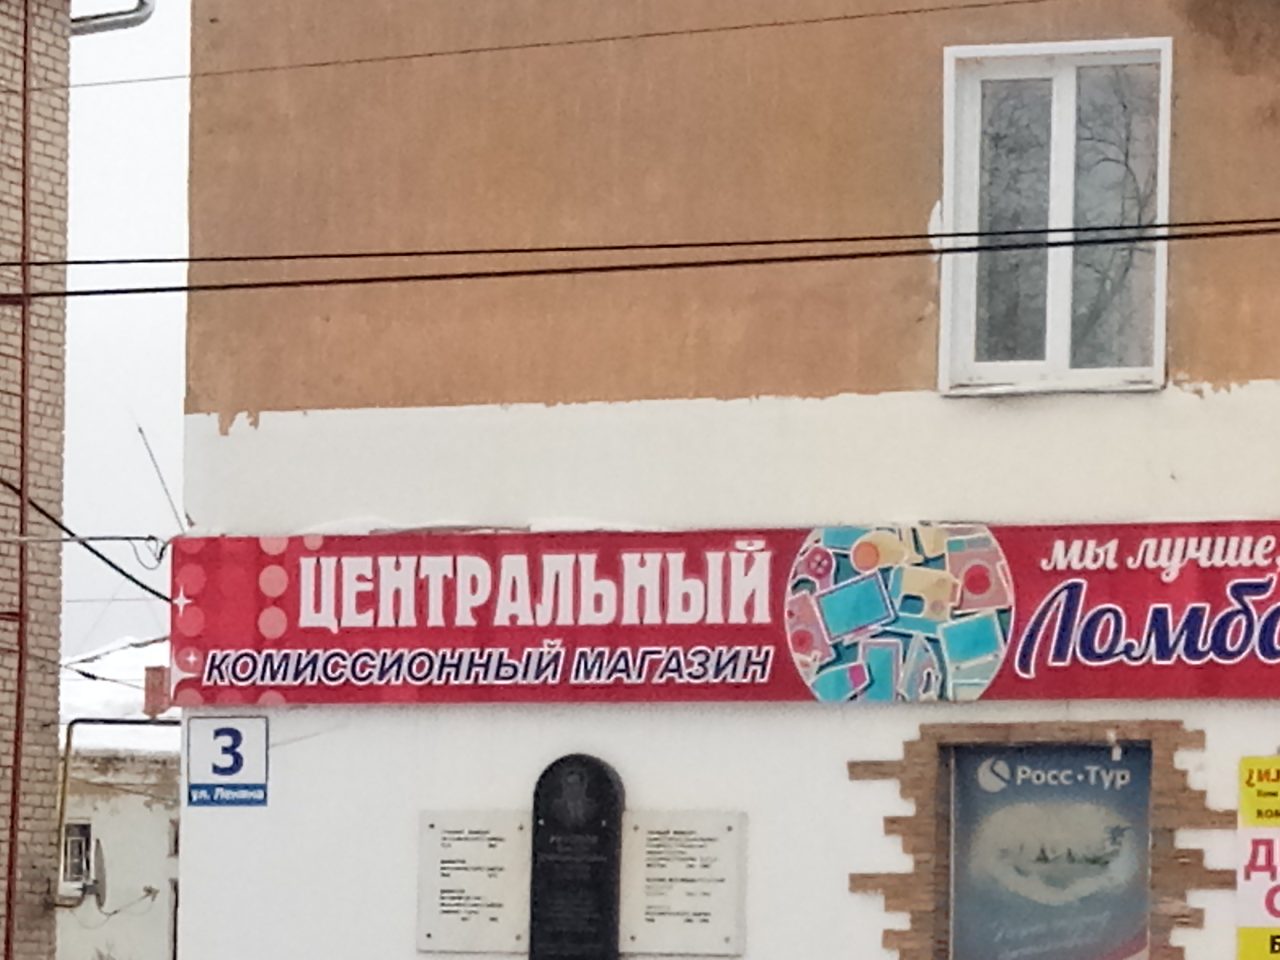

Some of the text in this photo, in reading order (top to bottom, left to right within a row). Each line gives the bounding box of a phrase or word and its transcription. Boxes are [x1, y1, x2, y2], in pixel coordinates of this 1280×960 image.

[1041, 538, 1119, 571] мы
[298, 538, 773, 633] ЦЕНТРАЛЬНЫЙ
[203, 639, 775, 687] КОМИССИОННЫЙ МАГАЗИН
[211, 727, 244, 776] 3
